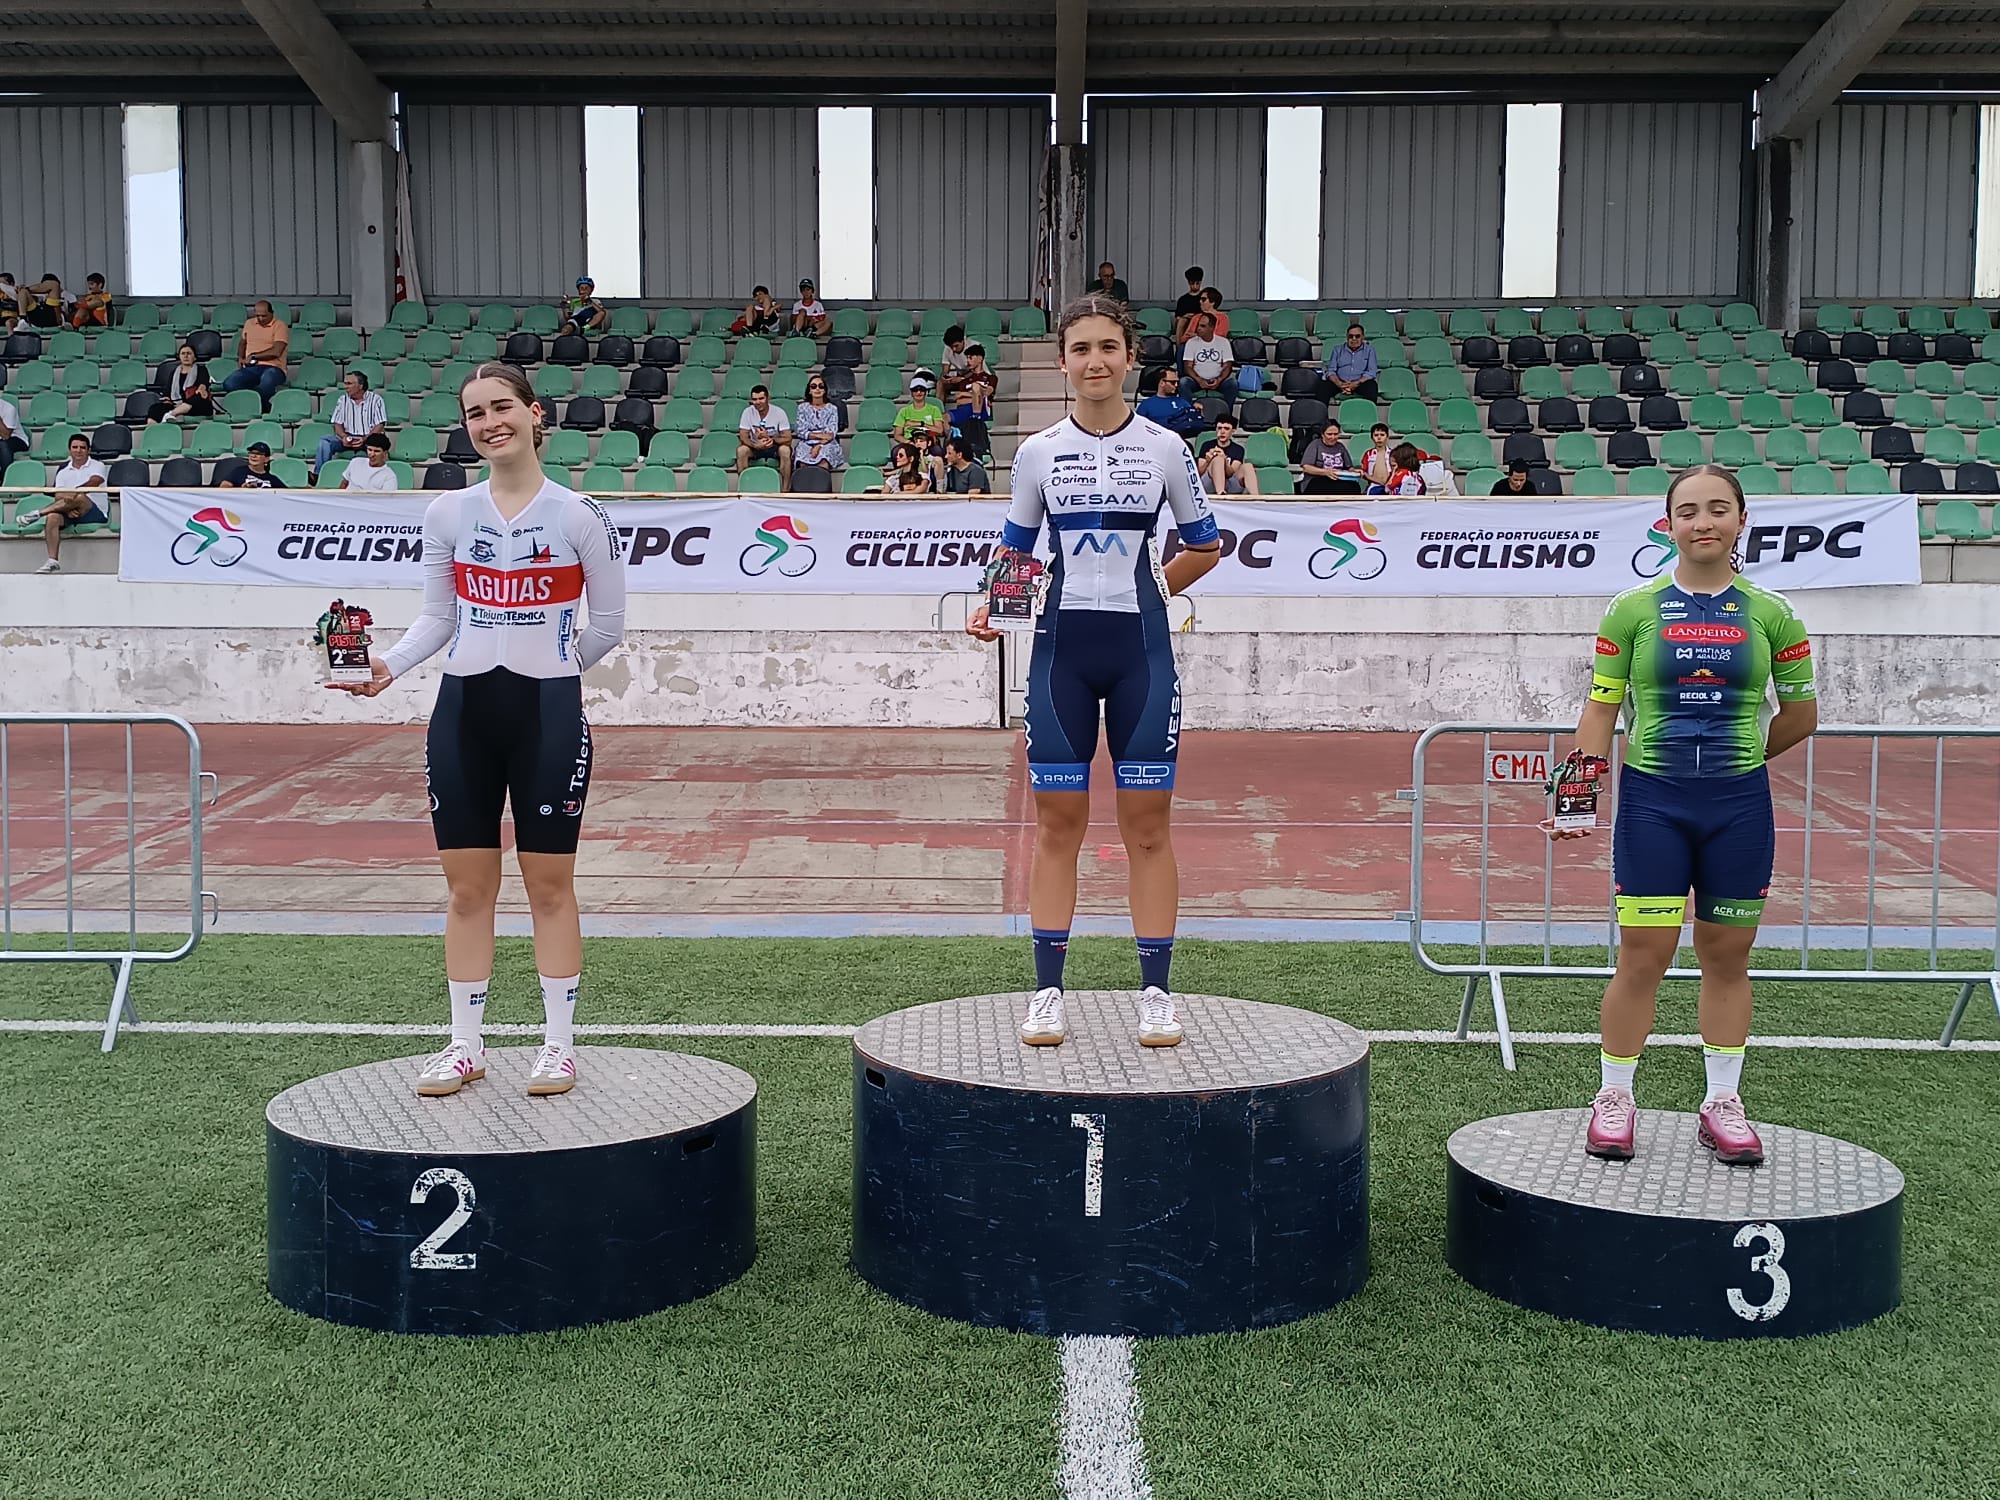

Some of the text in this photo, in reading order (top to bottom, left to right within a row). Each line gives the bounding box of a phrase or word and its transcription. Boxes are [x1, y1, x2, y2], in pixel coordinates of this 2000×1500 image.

[1056, 494, 1148, 507] VESAM
[283, 522, 423, 535] FEDERAÇÃO PORTUGUE
[850, 528, 922, 541] FEDERAÇÃO
[1420, 529, 1600, 542] FEDERAÇÃO PORTUGUESA DE
[1745, 520, 1866, 563] FPC
[278, 536, 424, 562] CICLISM
[846, 543, 999, 567] CICLISM
[1416, 543, 1596, 569] CICLISMO
[465, 567, 553, 603] ÁGUIAS
[1165, 663, 1180, 752] VESA
[1491, 753, 1547, 780] CMA
[1559, 783, 1594, 796] PISTA
[1071, 1113, 1106, 1217] 1
[410, 1168, 476, 1270] 2
[1727, 1223, 1791, 1321] 3
